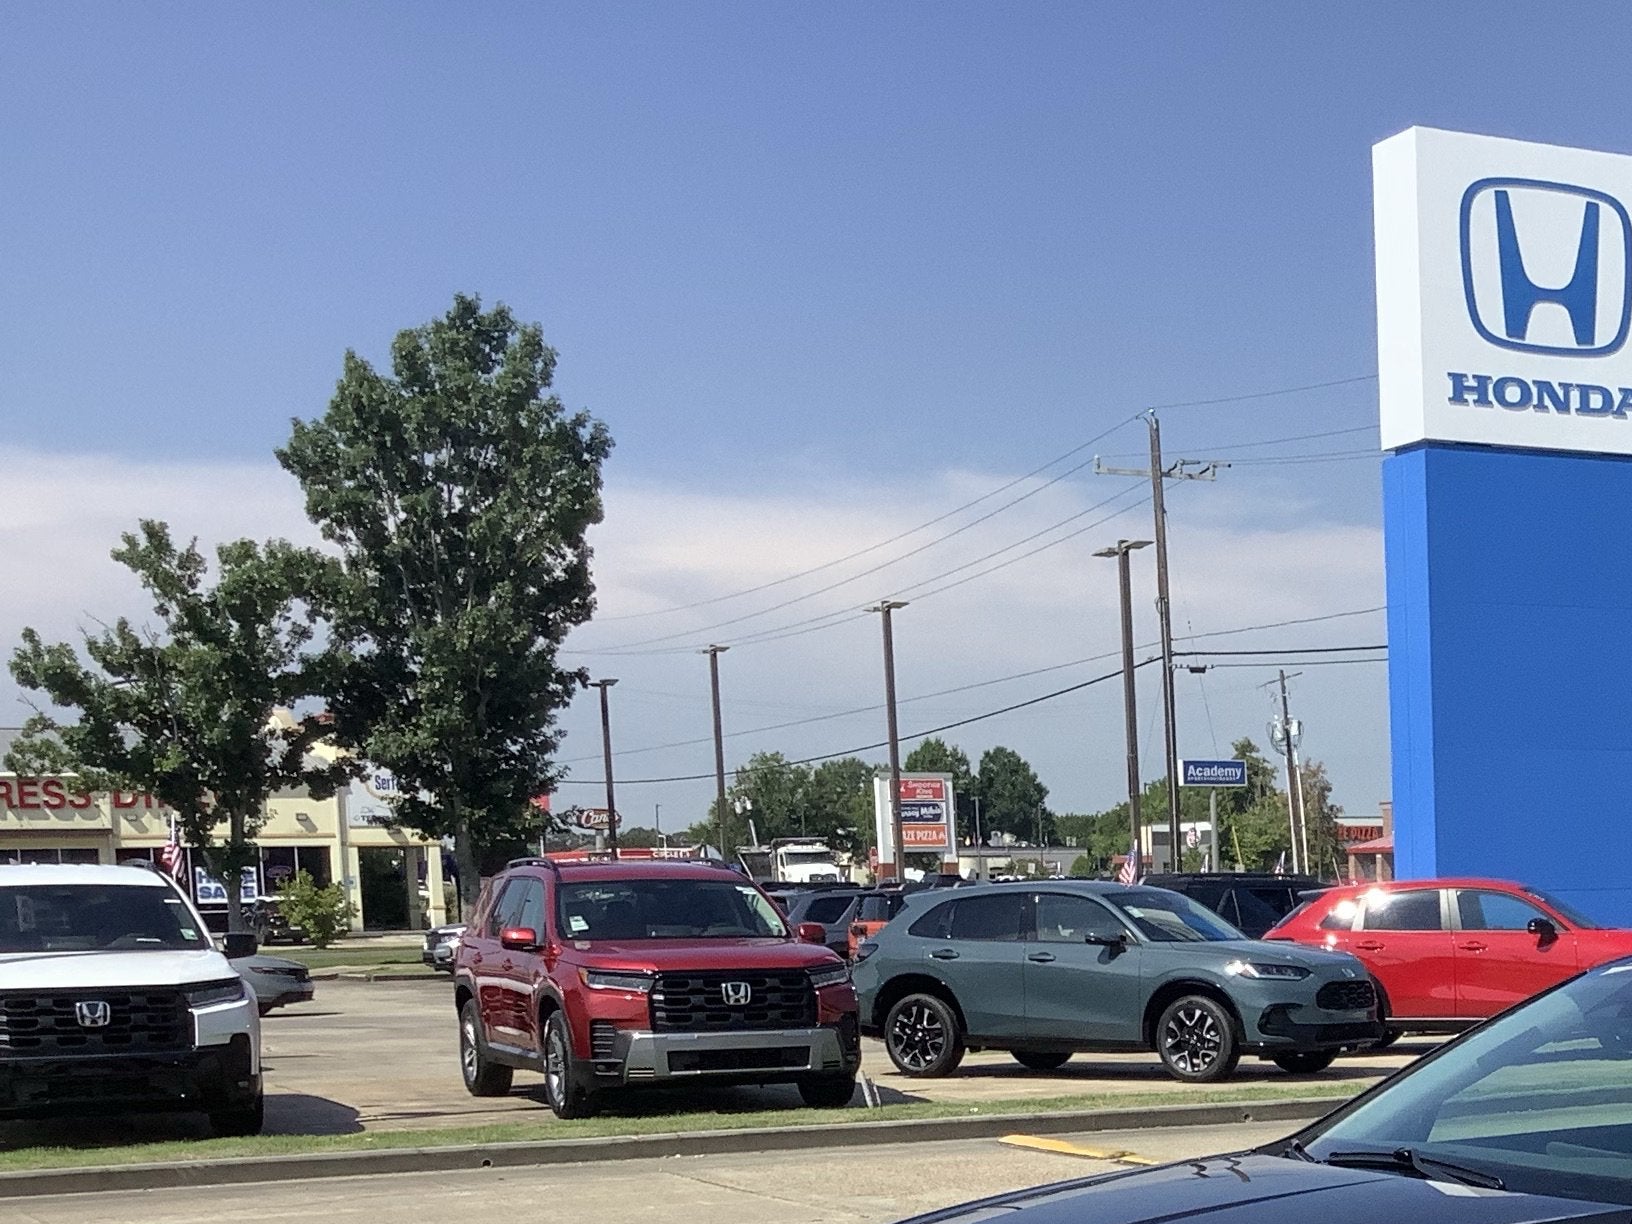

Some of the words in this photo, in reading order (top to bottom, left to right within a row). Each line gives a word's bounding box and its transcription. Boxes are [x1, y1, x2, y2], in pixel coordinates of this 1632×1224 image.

[1187, 765, 1242, 780] Academy
[374, 774, 400, 791] Sert
[917, 831, 938, 841] PIZZA
[199, 886, 255, 899] SAE
